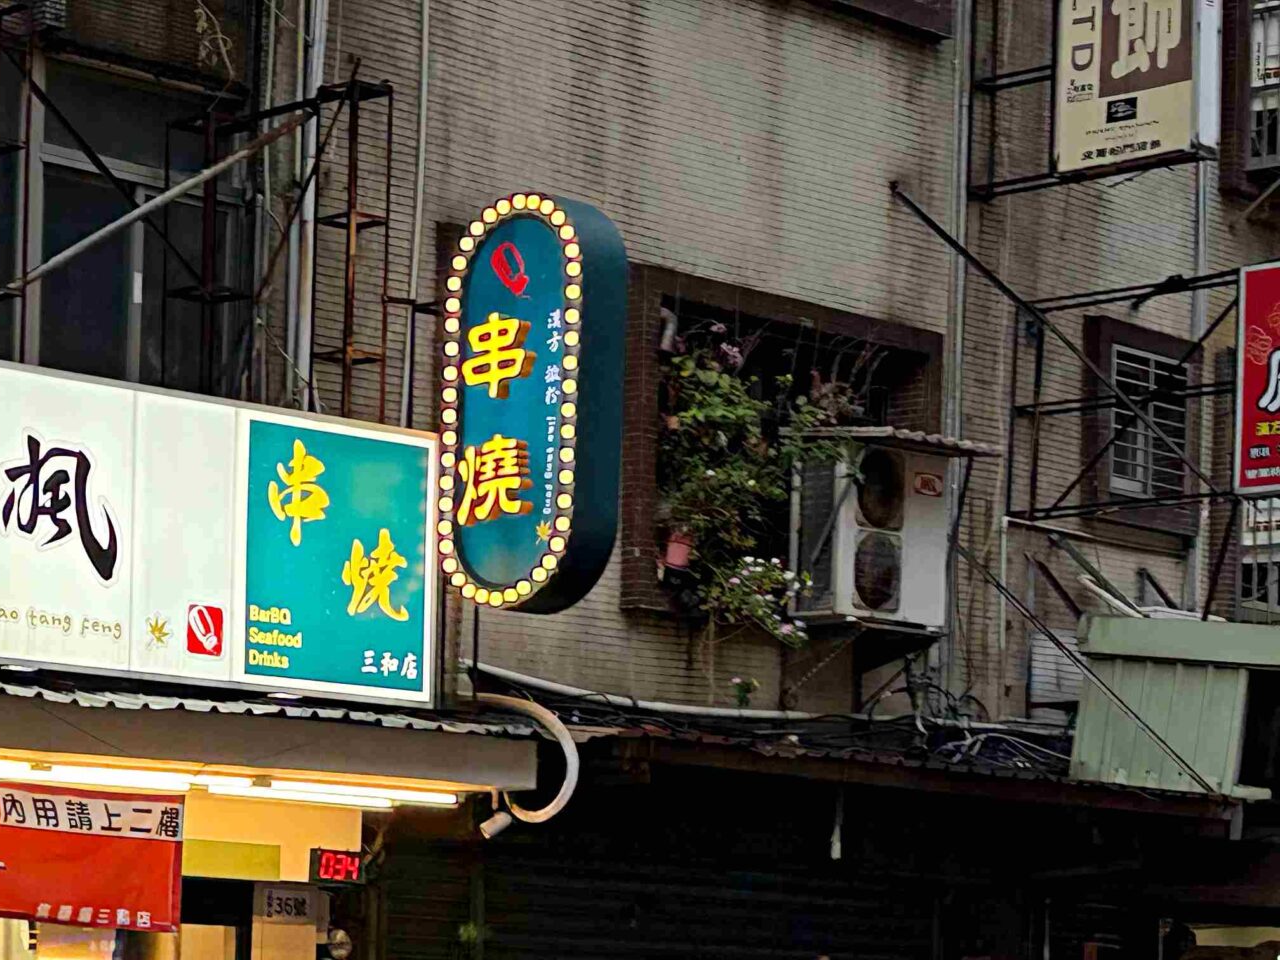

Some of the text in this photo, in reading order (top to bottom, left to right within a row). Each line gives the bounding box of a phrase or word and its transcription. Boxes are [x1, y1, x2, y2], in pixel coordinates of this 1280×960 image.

[1071, 0, 1096, 72] TD
[457, 312, 528, 525] 串燒
[28, 607, 71, 632] tang
[80, 617, 122, 639] feng
[249, 627, 302, 648] Seafood
[249, 649, 289, 669] Drinks
[361, 650, 418, 680] 三和店
[2, 792, 180, 838] 內用請上二樓
[320, 852, 360, 880] 034
